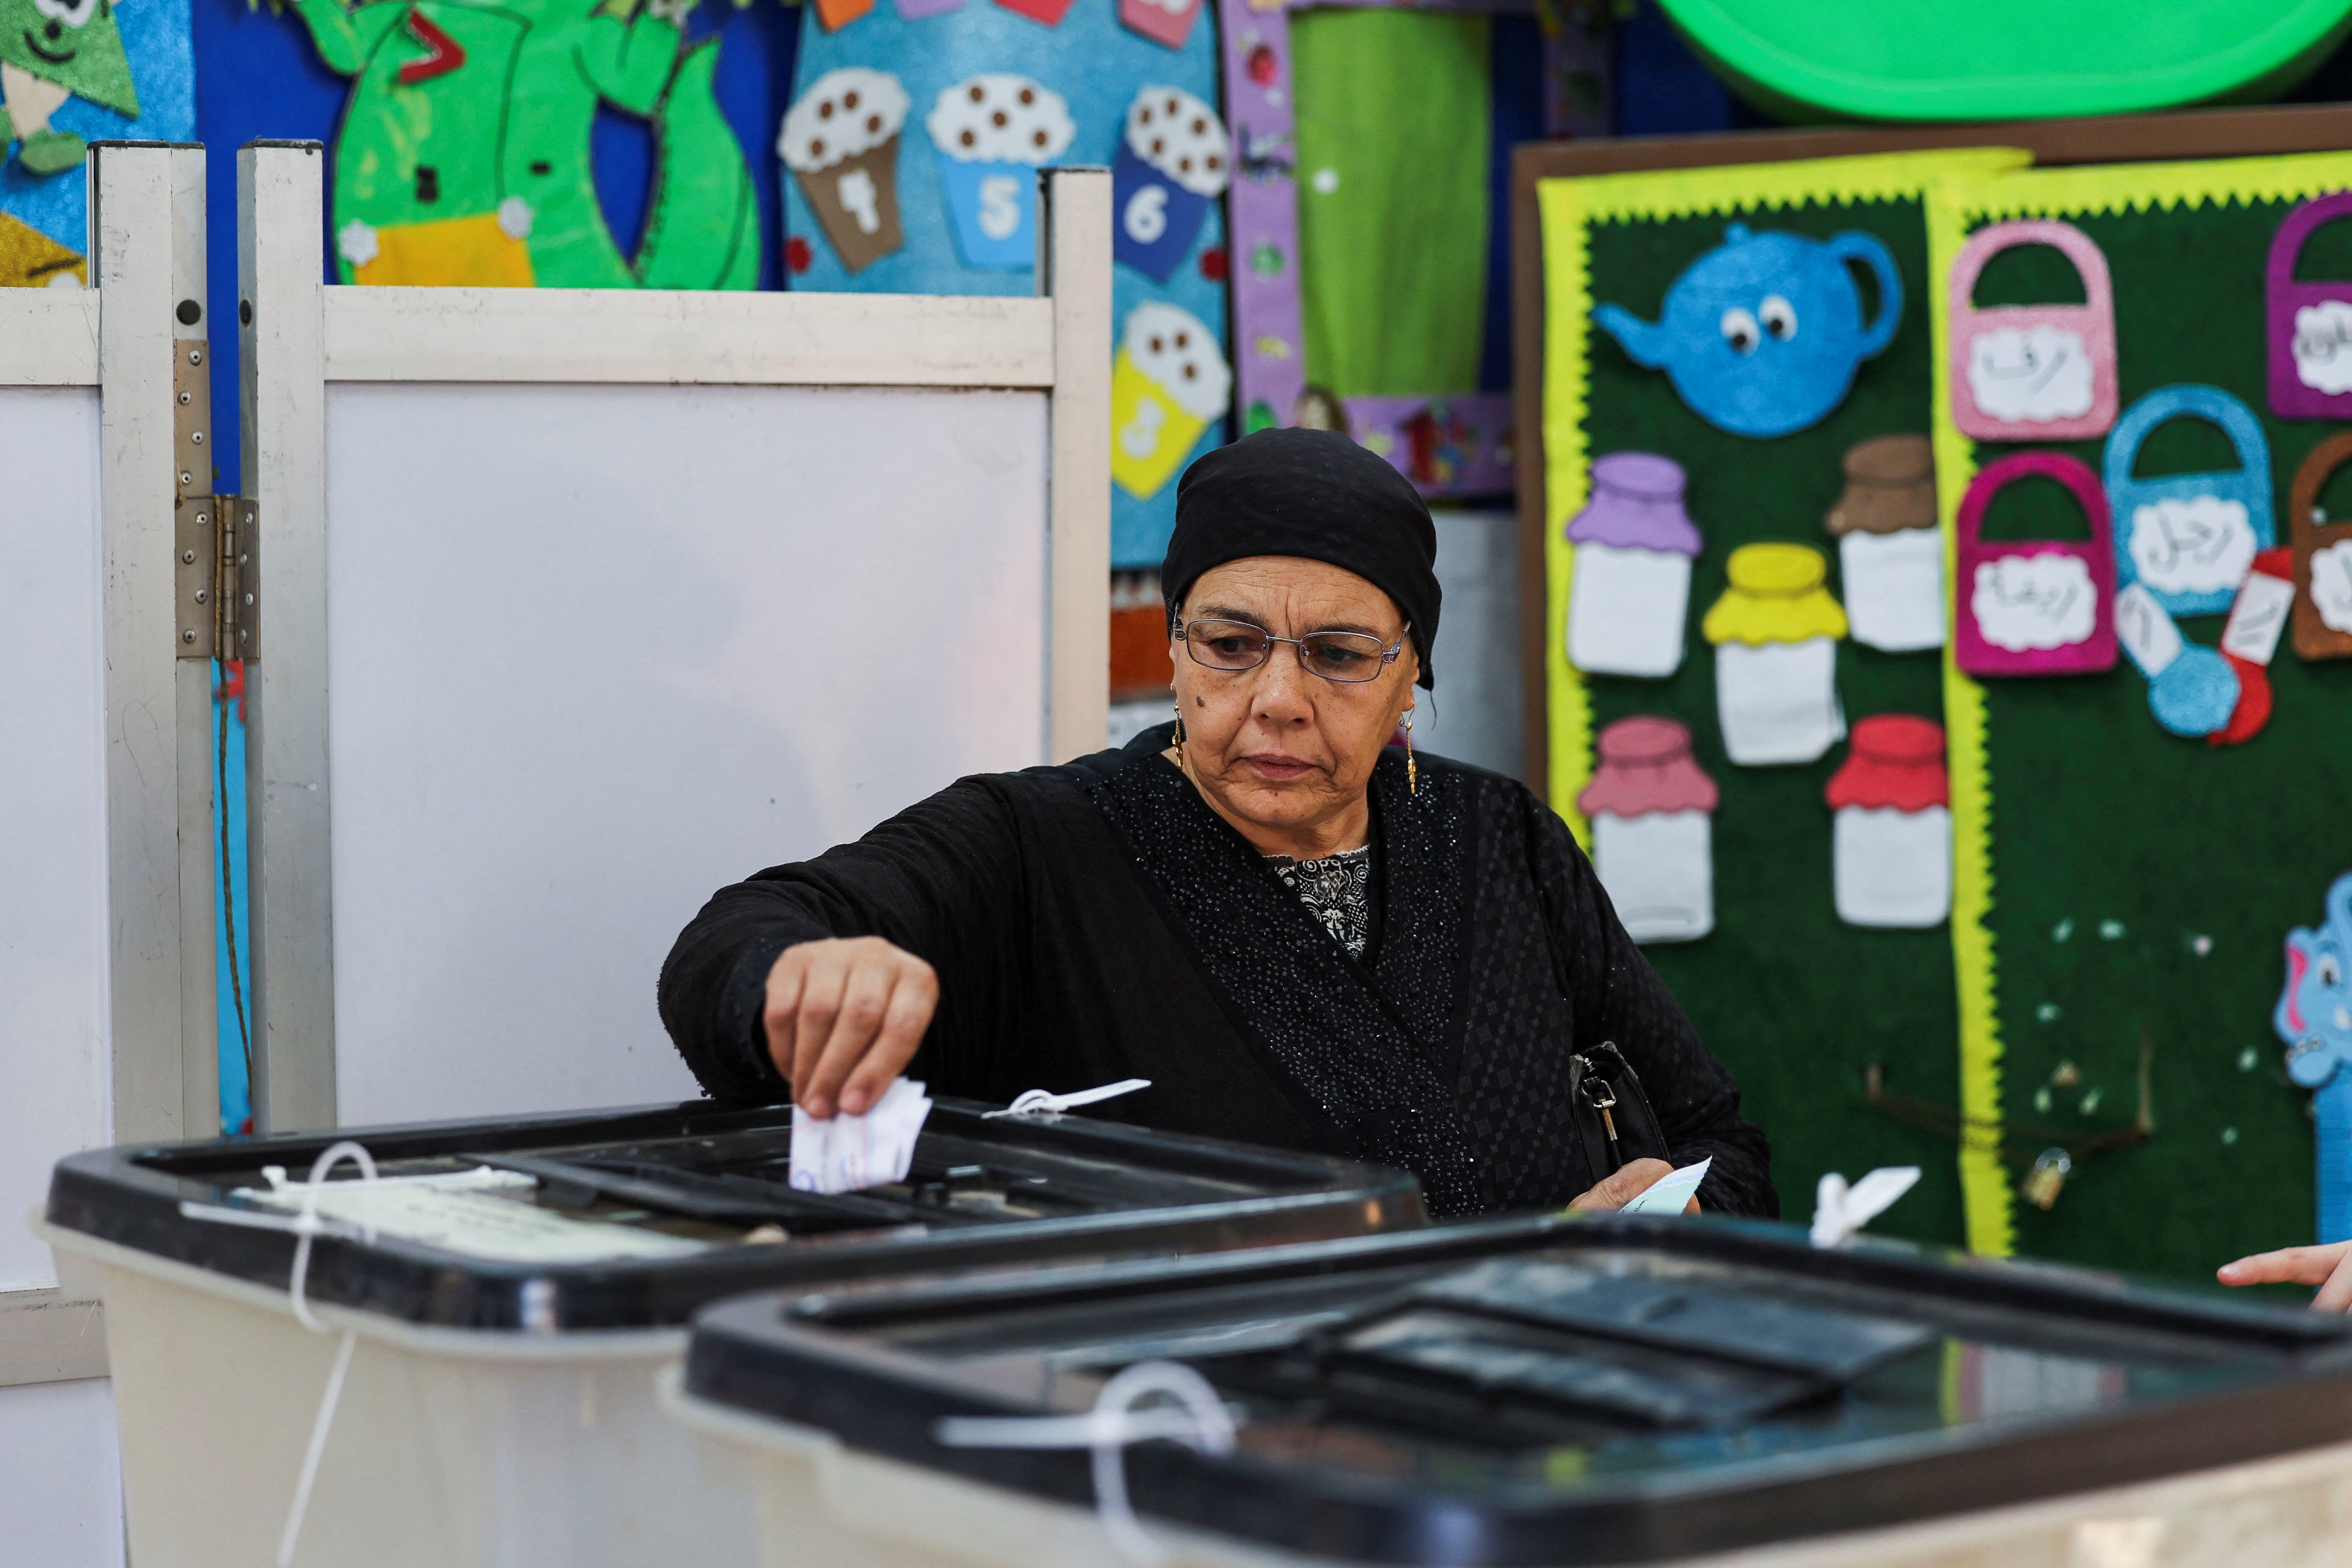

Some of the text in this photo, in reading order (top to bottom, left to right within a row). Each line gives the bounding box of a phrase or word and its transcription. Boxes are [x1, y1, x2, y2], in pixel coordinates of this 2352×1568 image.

[978, 176, 1021, 239] 5
[1123, 184, 1169, 244] 6
[2146, 512, 2235, 574] رجل
